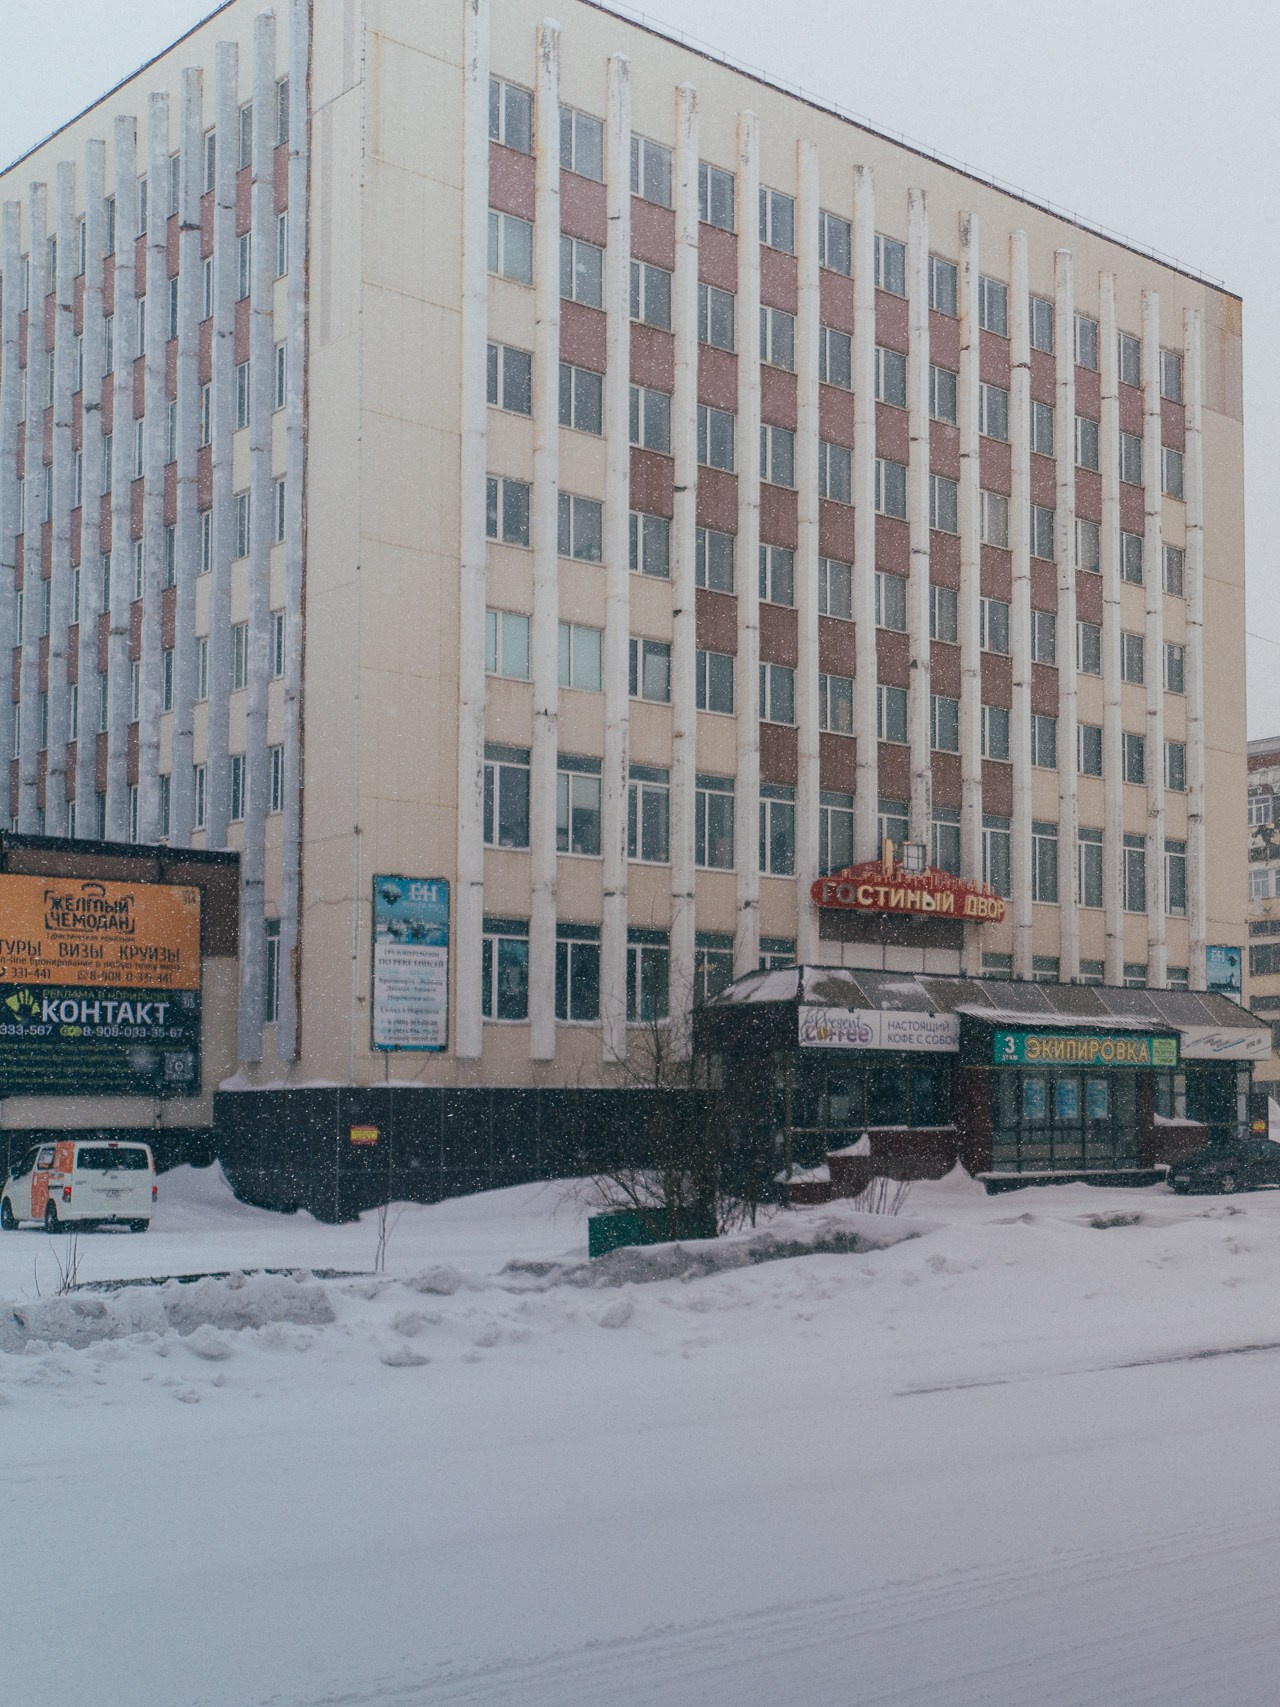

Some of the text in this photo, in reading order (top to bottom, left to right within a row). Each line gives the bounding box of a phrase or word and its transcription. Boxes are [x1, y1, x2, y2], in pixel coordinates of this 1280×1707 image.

[822, 882, 1004, 918] ГОСТИНЫЙ ДВОР
[50, 911, 129, 931] ЧЕМОДАН
[59, 942, 103, 959] ВИЗЫ
[119, 945, 180, 962] КРУИЗЫ
[12, 967, 50, 979] 331-441
[42, 989, 94, 999] РЕКЛАМА
[42, 999, 170, 1025] КОНТАКТ
[887, 1020, 949, 1033] НАСТОЯЩИЙ
[887, 1033, 914, 1044] КОФЕ
[916, 1035, 922, 1044] С
[1004, 1036, 1015, 1054] 3
[1025, 1035, 1150, 1063] ЭКИПИРОВКА
